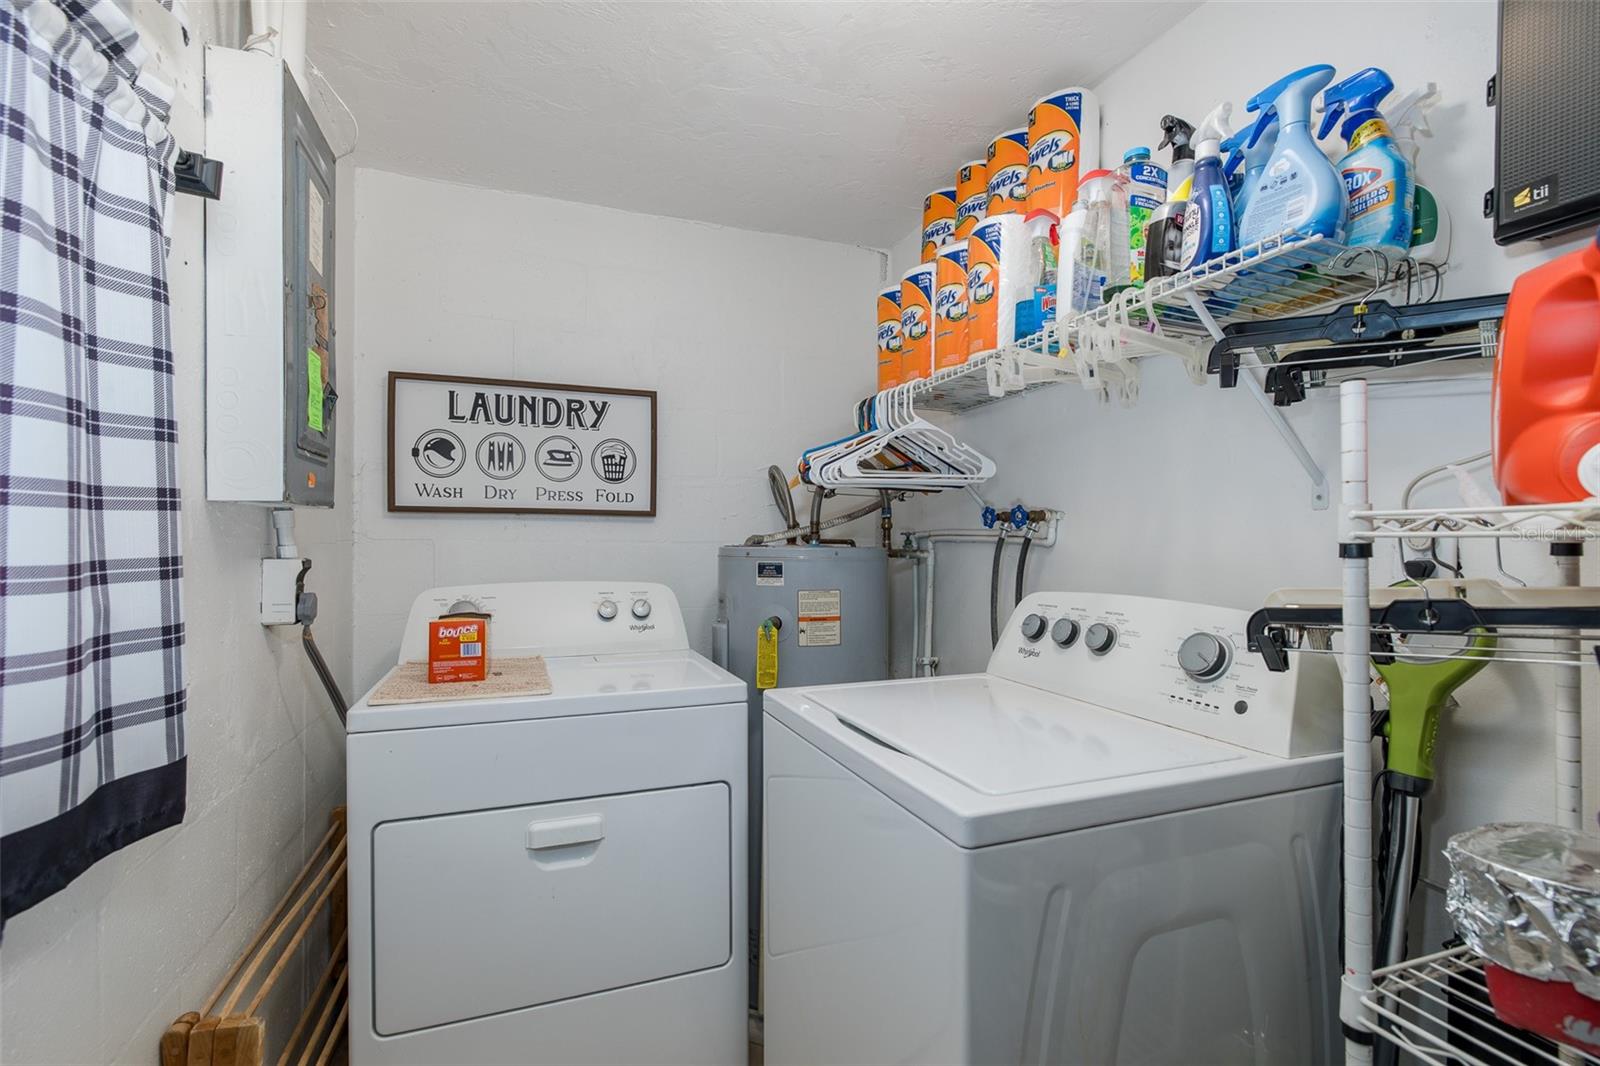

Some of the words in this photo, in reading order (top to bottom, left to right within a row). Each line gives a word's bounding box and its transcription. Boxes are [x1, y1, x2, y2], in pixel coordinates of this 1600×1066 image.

[1143, 166, 1159, 177] 2X
[1533, 184, 1549, 200] tii
[448, 390, 610, 431] LAUNDRY
[439, 624, 478, 638] bounce
[1018, 647, 1041, 659] Whirlpool
